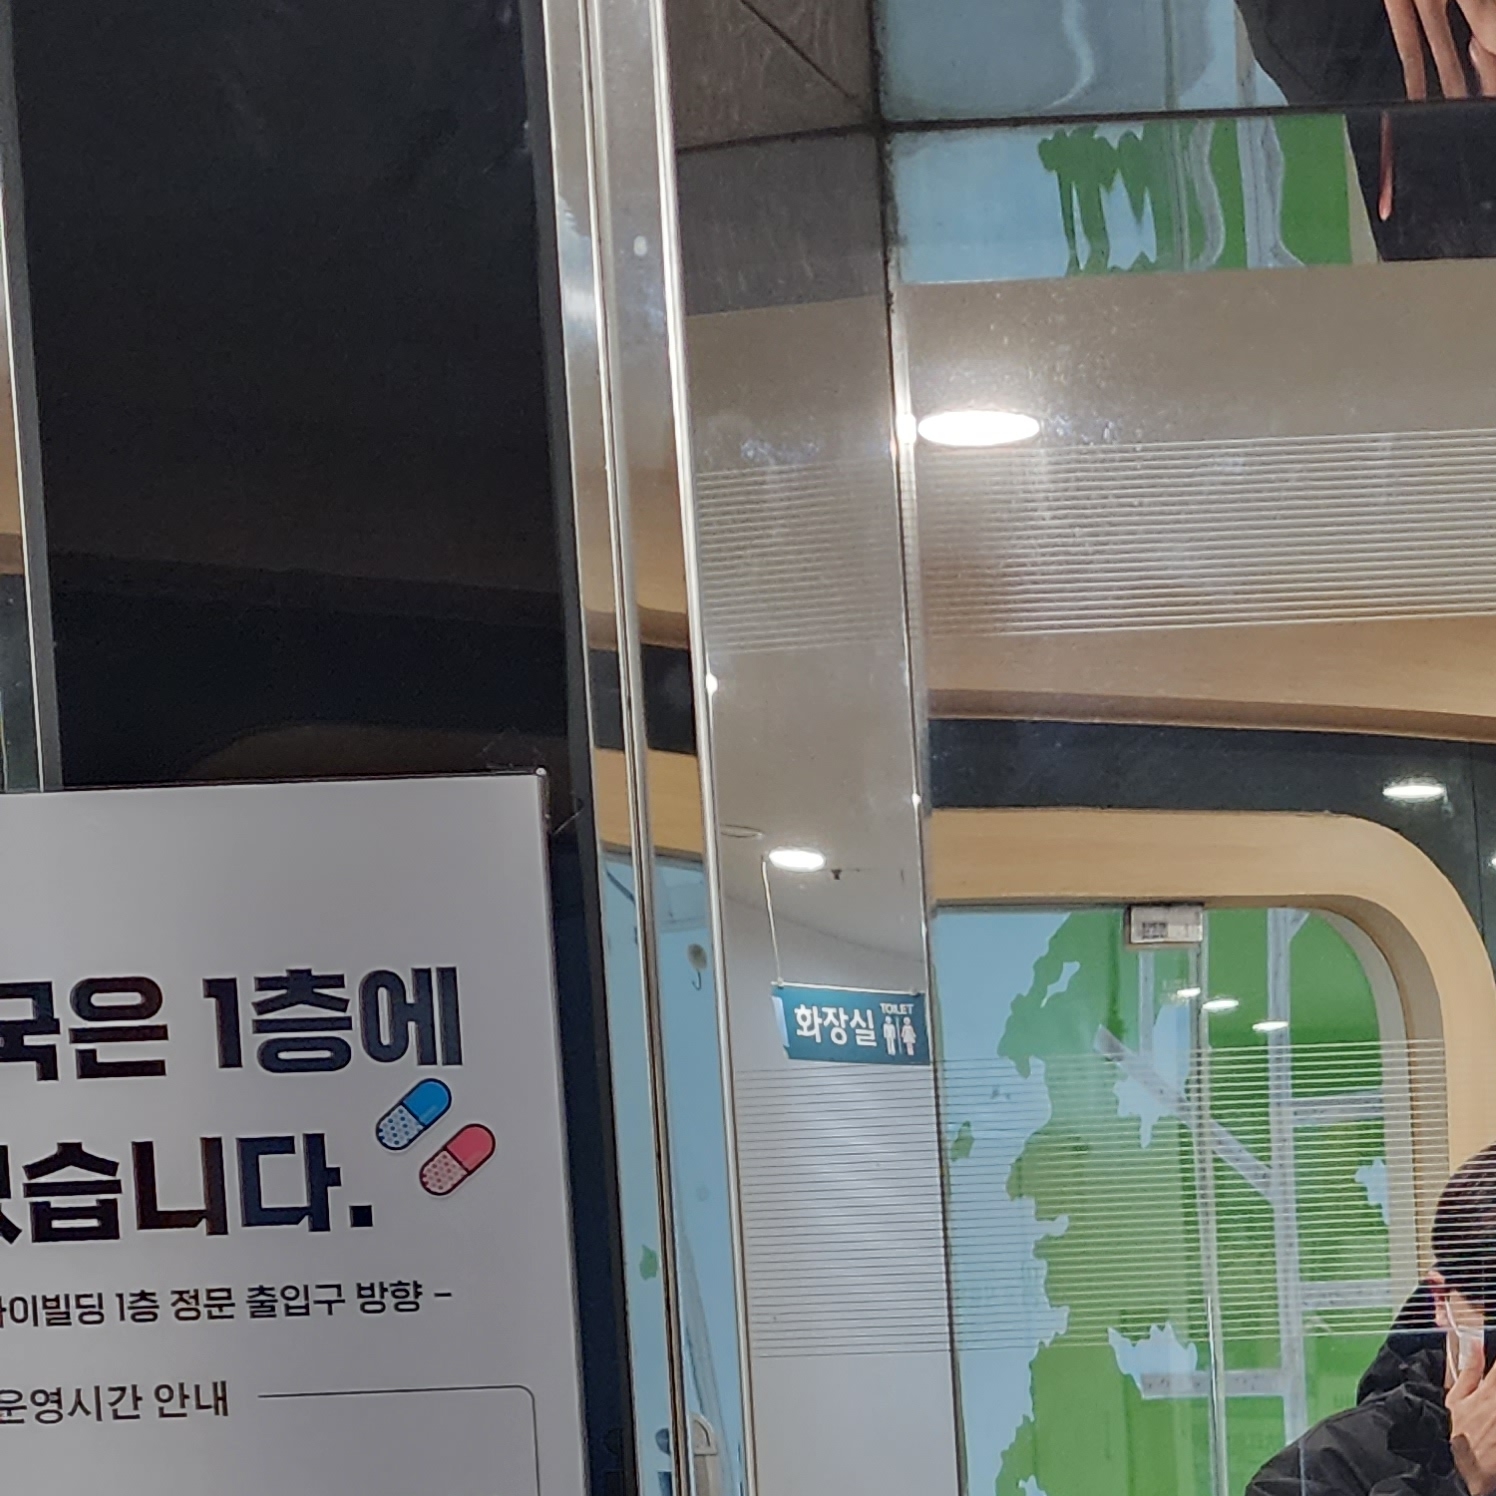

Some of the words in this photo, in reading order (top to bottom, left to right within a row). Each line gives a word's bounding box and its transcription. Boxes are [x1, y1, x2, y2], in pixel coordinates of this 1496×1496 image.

[203, 967, 462, 1073] 1층에
[794, 1003, 877, 1047] 화장실
[879, 1003, 915, 1015] TOILET
[0, 1293, 104, 1328] 이빌딩
[116, 1290, 159, 1322] 1층
[171, 1288, 235, 1321] 정문
[246, 1284, 345, 1318] 출입구
[357, 1280, 423, 1313] 방향
[0, 1384, 143, 1424] 운영시간
[155, 1381, 228, 1418] 안내
